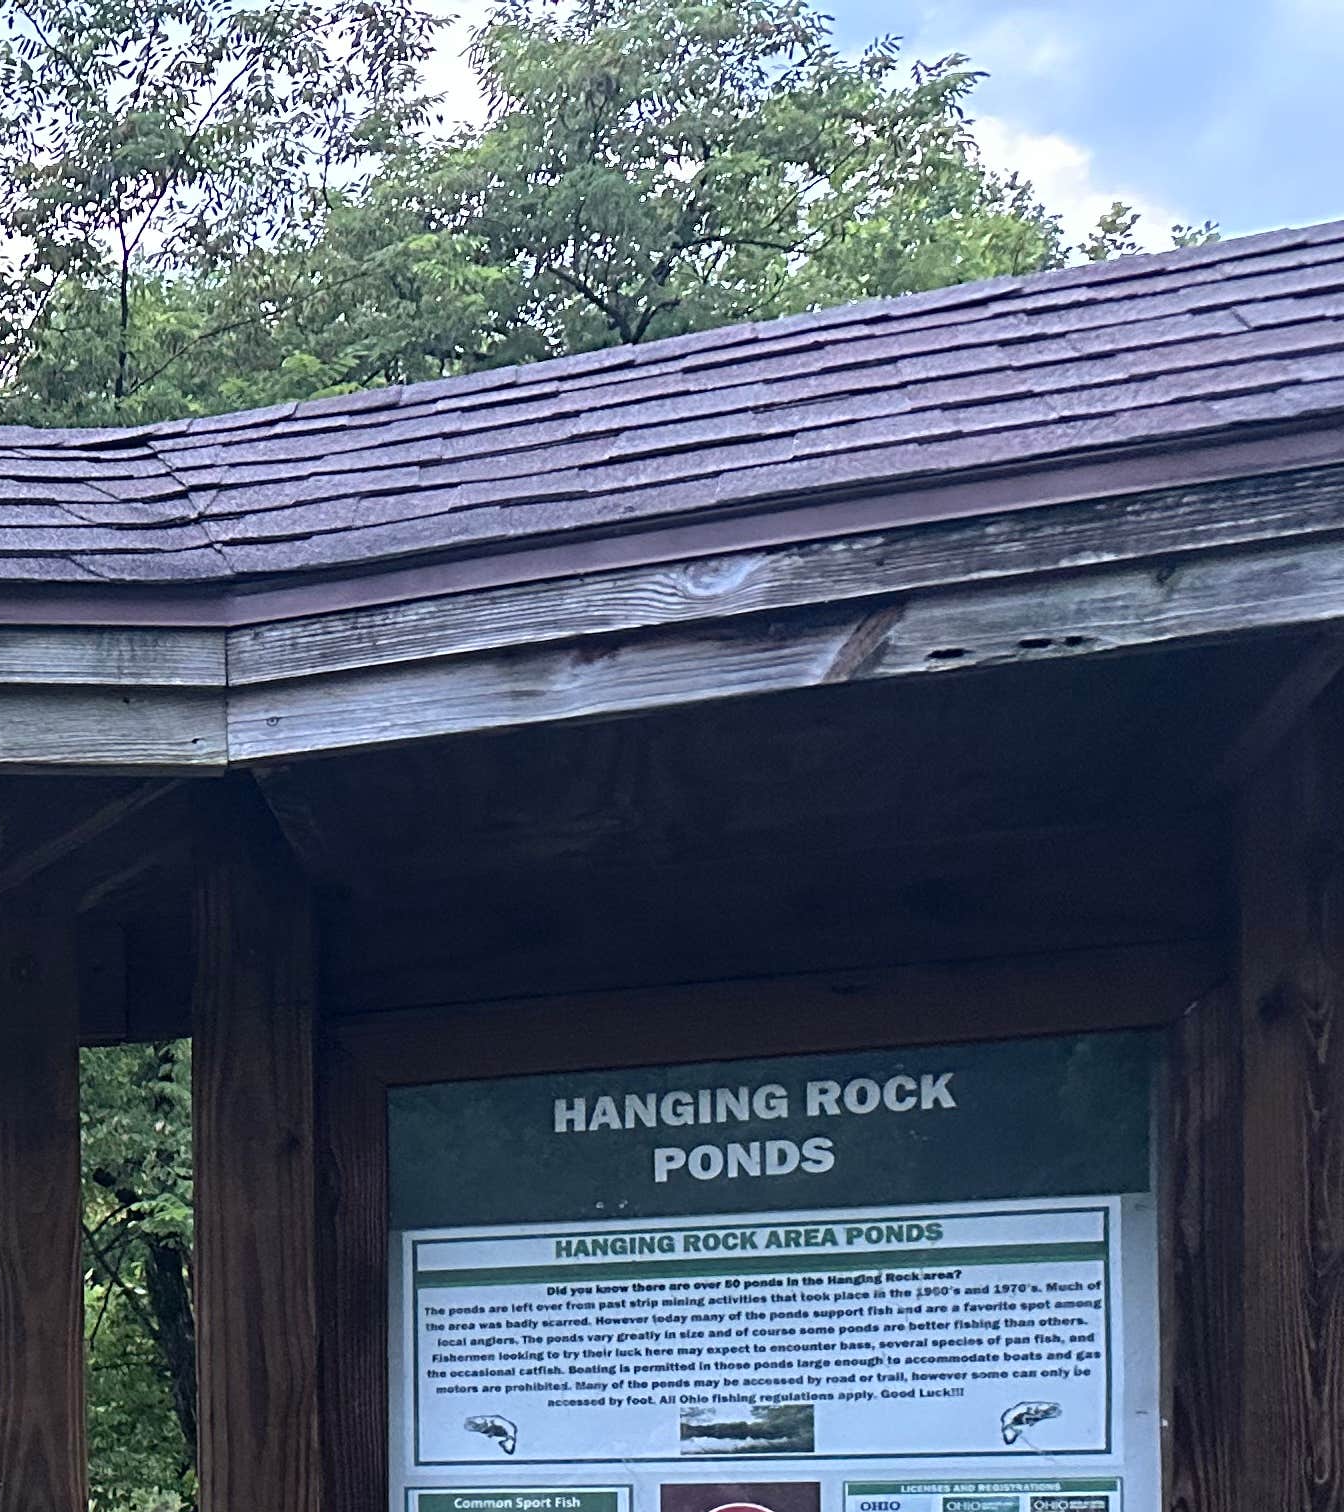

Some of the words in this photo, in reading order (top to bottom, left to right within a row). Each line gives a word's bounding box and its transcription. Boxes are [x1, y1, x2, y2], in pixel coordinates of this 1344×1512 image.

[554, 1084, 789, 1133] HANGING
[806, 1073, 957, 1117] ROCK
[654, 1137, 835, 1183] PONDS
[555, 1236, 674, 1258] HANGING
[684, 1231, 758, 1252] ROCK
[766, 1227, 838, 1248] AREA
[846, 1223, 944, 1245] PONDS
[546, 1286, 568, 1296] Did
[570, 1287, 593, 1297] you
[595, 1284, 629, 1294] know
[631, 1282, 666, 1293] there
[668, 1283, 691, 1291] are
[693, 1281, 722, 1290] over
[743, 1278, 784, 1290] ponds
[786, 1277, 799, 1287] in
[801, 1276, 824, 1286] the
[827, 1274, 883, 1286] Hanging
[885, 1271, 921, 1283] Rock
[922, 1269, 962, 1281] area?
[901, 1485, 956, 1494] LICENSES
[959, 1485, 975, 1493] AND
[978, 1483, 1061, 1493] REGISTRATIONS
[453, 1497, 513, 1509] Common
[516, 1497, 552, 1511] Sport
[554, 1496, 581, 1508] Fish
[860, 1501, 901, 1512] OHIO
